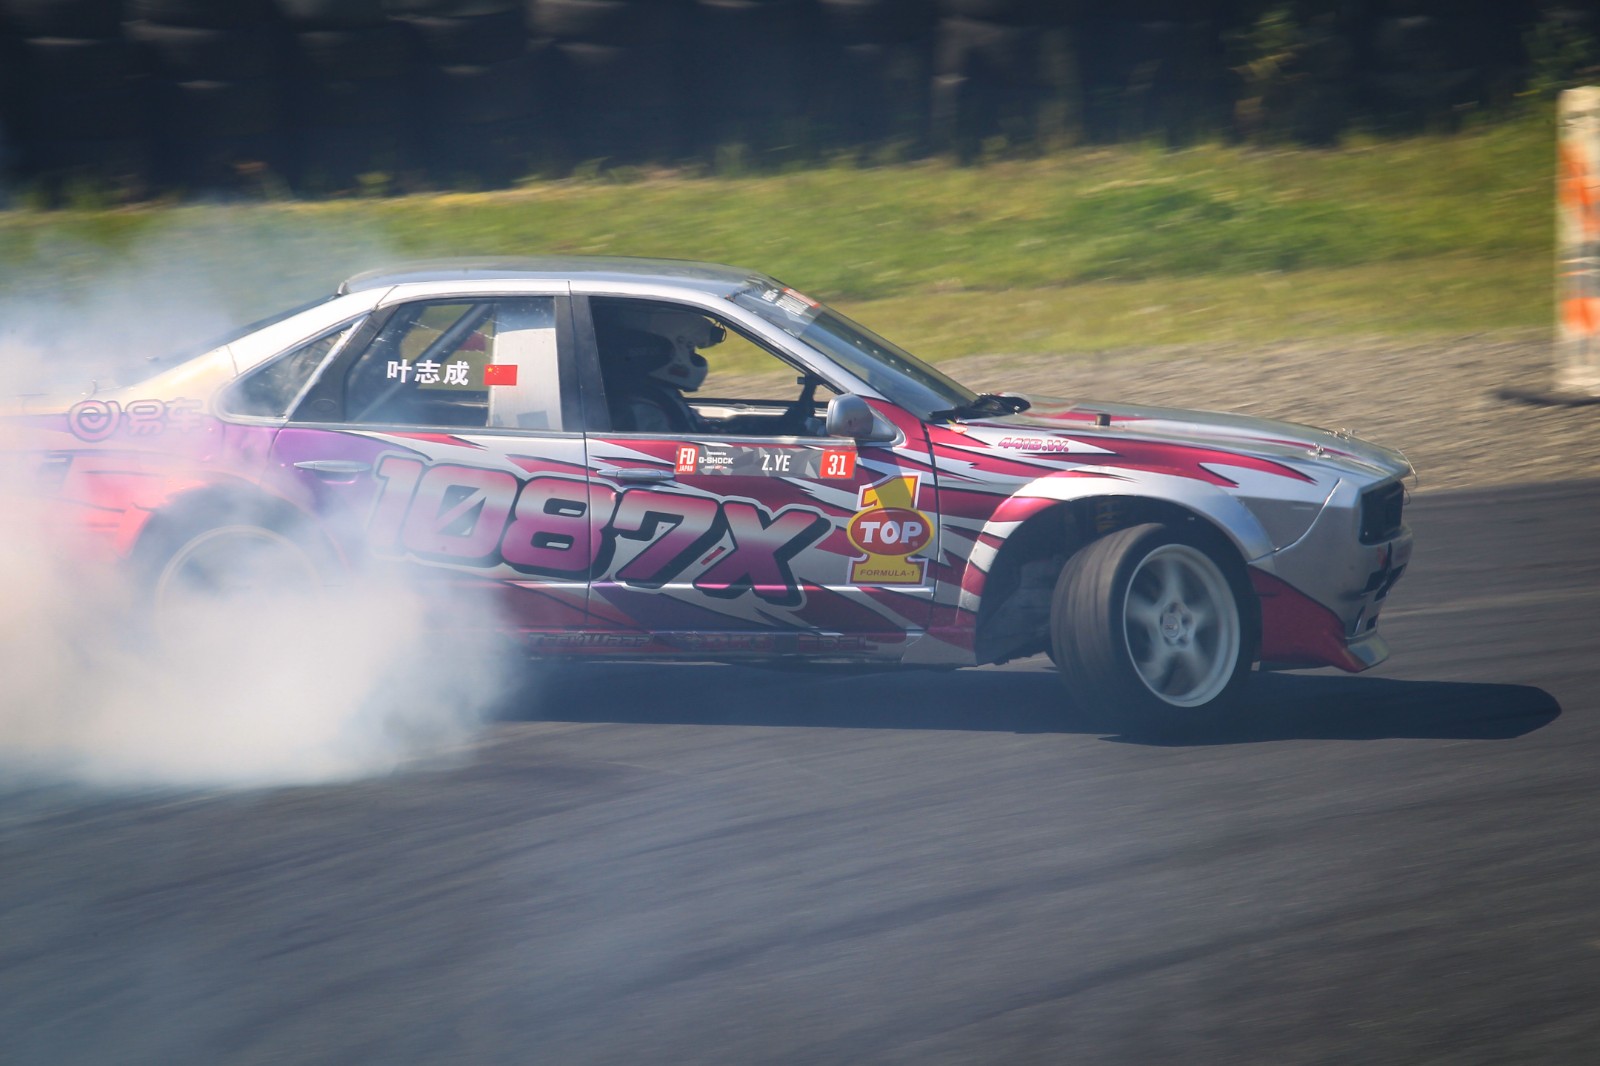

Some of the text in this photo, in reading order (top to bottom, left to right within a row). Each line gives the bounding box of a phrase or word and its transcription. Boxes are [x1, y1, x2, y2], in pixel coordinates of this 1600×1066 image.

[386, 359, 470, 386] 叶志成
[679, 447, 696, 465] FD
[698, 456, 734, 465] G-SHOCK
[761, 454, 791, 472] Z.YE
[827, 454, 847, 476] 31
[678, 464, 694, 472] JAPAN
[370, 455, 831, 606] 1087X
[860, 520, 923, 545] TOP
[859, 568, 916, 577] FORMULA-1
